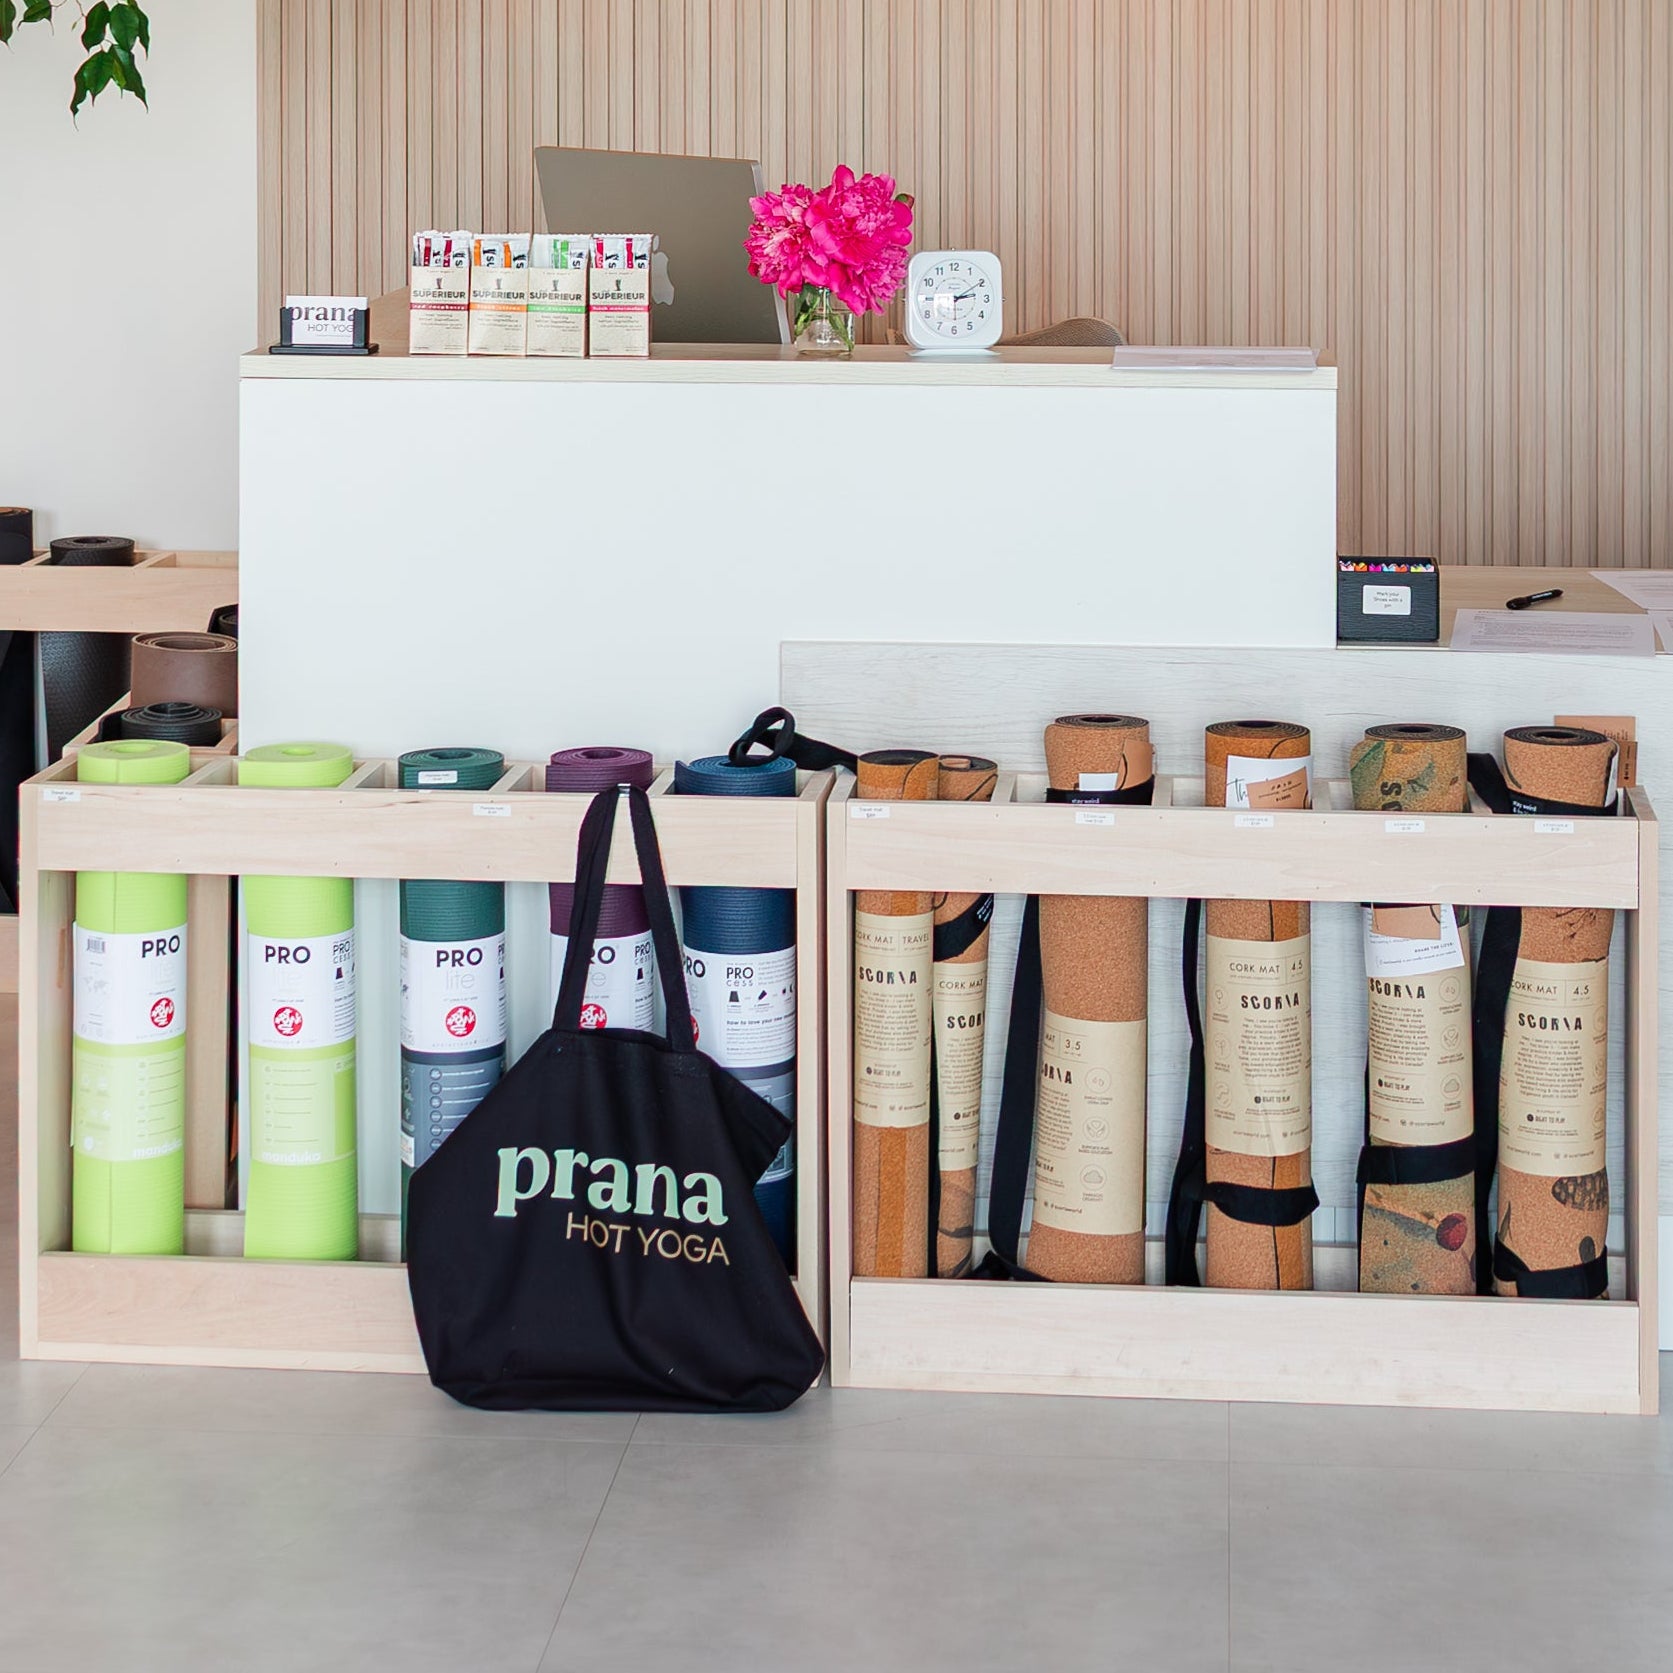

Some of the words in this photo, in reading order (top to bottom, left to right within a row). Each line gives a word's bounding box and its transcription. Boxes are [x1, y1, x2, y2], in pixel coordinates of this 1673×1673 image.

[935, 267, 944, 276] 11
[949, 263, 960, 272] 12
[924, 278, 934, 287] 10
[979, 279, 985, 287] 2
[983, 294, 990, 303] 3
[924, 310, 931, 319] 8
[978, 310, 985, 319] 4
[307, 323, 328, 332] HOT
[937, 322, 942, 330] 7
[951, 326, 958, 335] 6
[967, 322, 973, 330] 5
[857, 930, 871, 940] ORK
[874, 936, 893, 944] MAT
[141, 935, 181, 958] PRO
[333, 941, 350, 956] PRO
[634, 941, 651, 958] PRO
[265, 945, 311, 964] PRO
[436, 947, 483, 968] PRO
[684, 955, 706, 978] RO
[726, 966, 754, 979] PRO
[1229, 962, 1255, 973] CORK
[1258, 965, 1280, 974] MAT
[446, 970, 475, 990] lite
[939, 981, 965, 990] CORK
[969, 978, 983, 987] MAT
[1536, 985, 1558, 995] MAT
[1573, 984, 1590, 996] 4.5
[1065, 1039, 1081, 1051] 3.5
[494, 1147, 729, 1226] prana
[566, 1212, 631, 1253] HOT
[637, 1226, 730, 1266] YOGA
